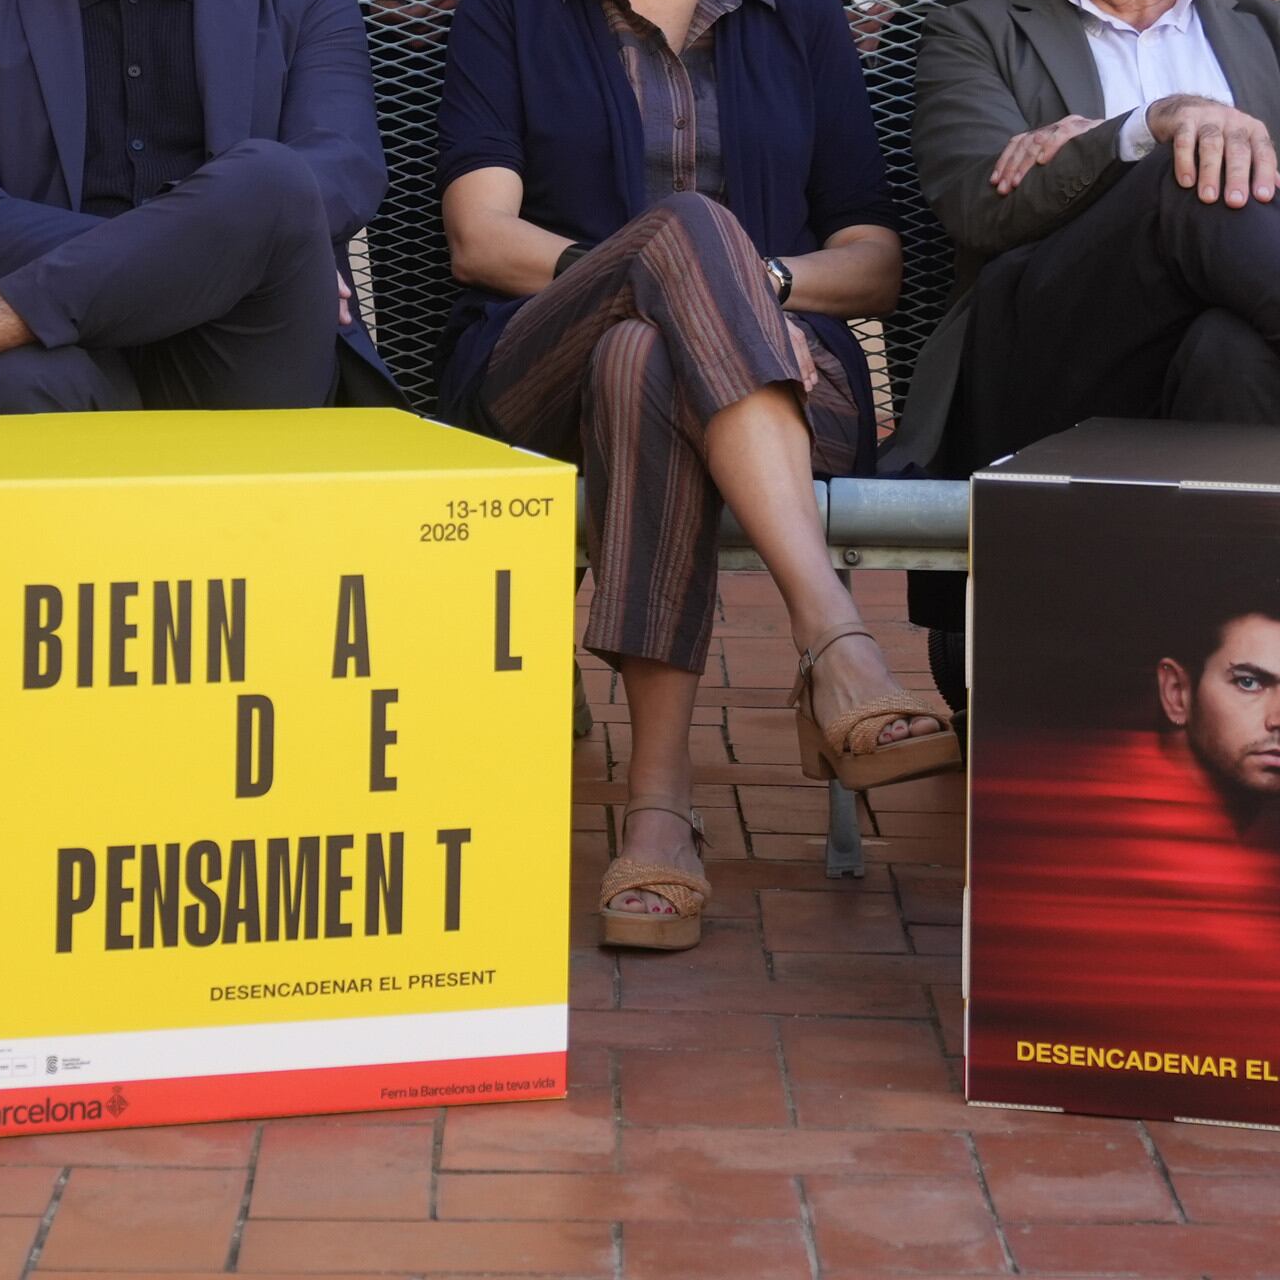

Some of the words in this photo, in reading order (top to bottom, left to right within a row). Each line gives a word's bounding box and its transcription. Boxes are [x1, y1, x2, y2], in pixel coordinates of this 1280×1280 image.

[445, 500, 502, 519] 13-18
[508, 498, 554, 518] OCT
[420, 523, 470, 543] 2026
[209, 977, 373, 1002] DESENCADENAR
[379, 976, 402, 991] EL
[408, 970, 497, 990] PRESENT
[1017, 1040, 1238, 1079] DESENCADENAR
[1246, 1059, 1280, 1082] EL
[380, 1087, 408, 1100] Fem
[420, 1083, 476, 1098] Barcelona
[478, 1081, 493, 1094] de
[495, 1080, 504, 1092] la
[506, 1079, 530, 1091] teva
[532, 1078, 556, 1089] vida
